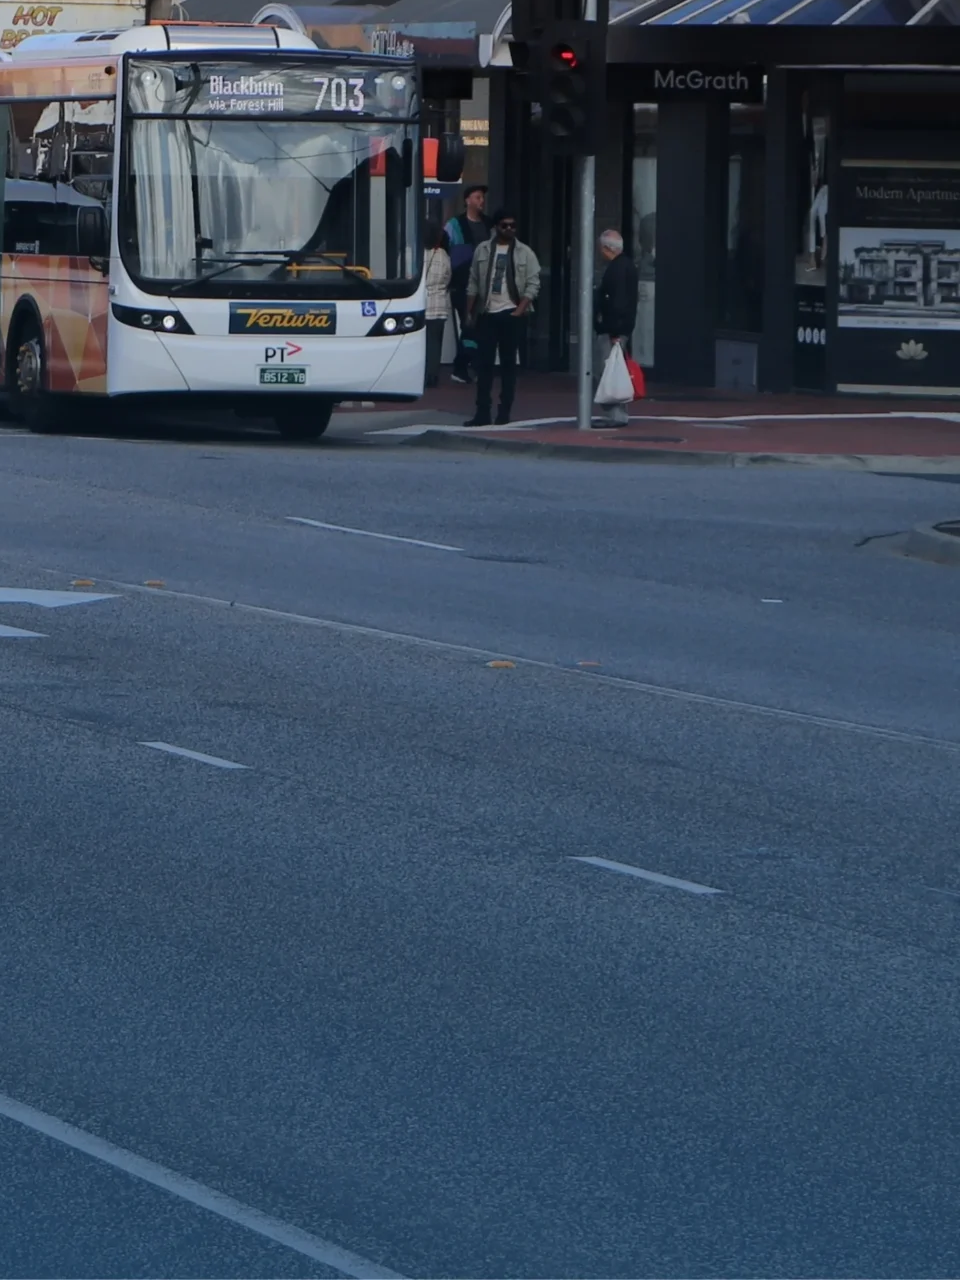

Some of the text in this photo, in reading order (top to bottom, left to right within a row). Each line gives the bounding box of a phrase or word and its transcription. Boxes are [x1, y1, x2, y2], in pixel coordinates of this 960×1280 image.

[12, 4, 64, 26] HOT
[653, 69, 749, 90] McGrath
[209, 75, 366, 112] Blackburn 703
[208, 98, 284, 112] via Forest Hill
[855, 185, 903, 199] Modern
[236, 308, 331, 328] Ventura
